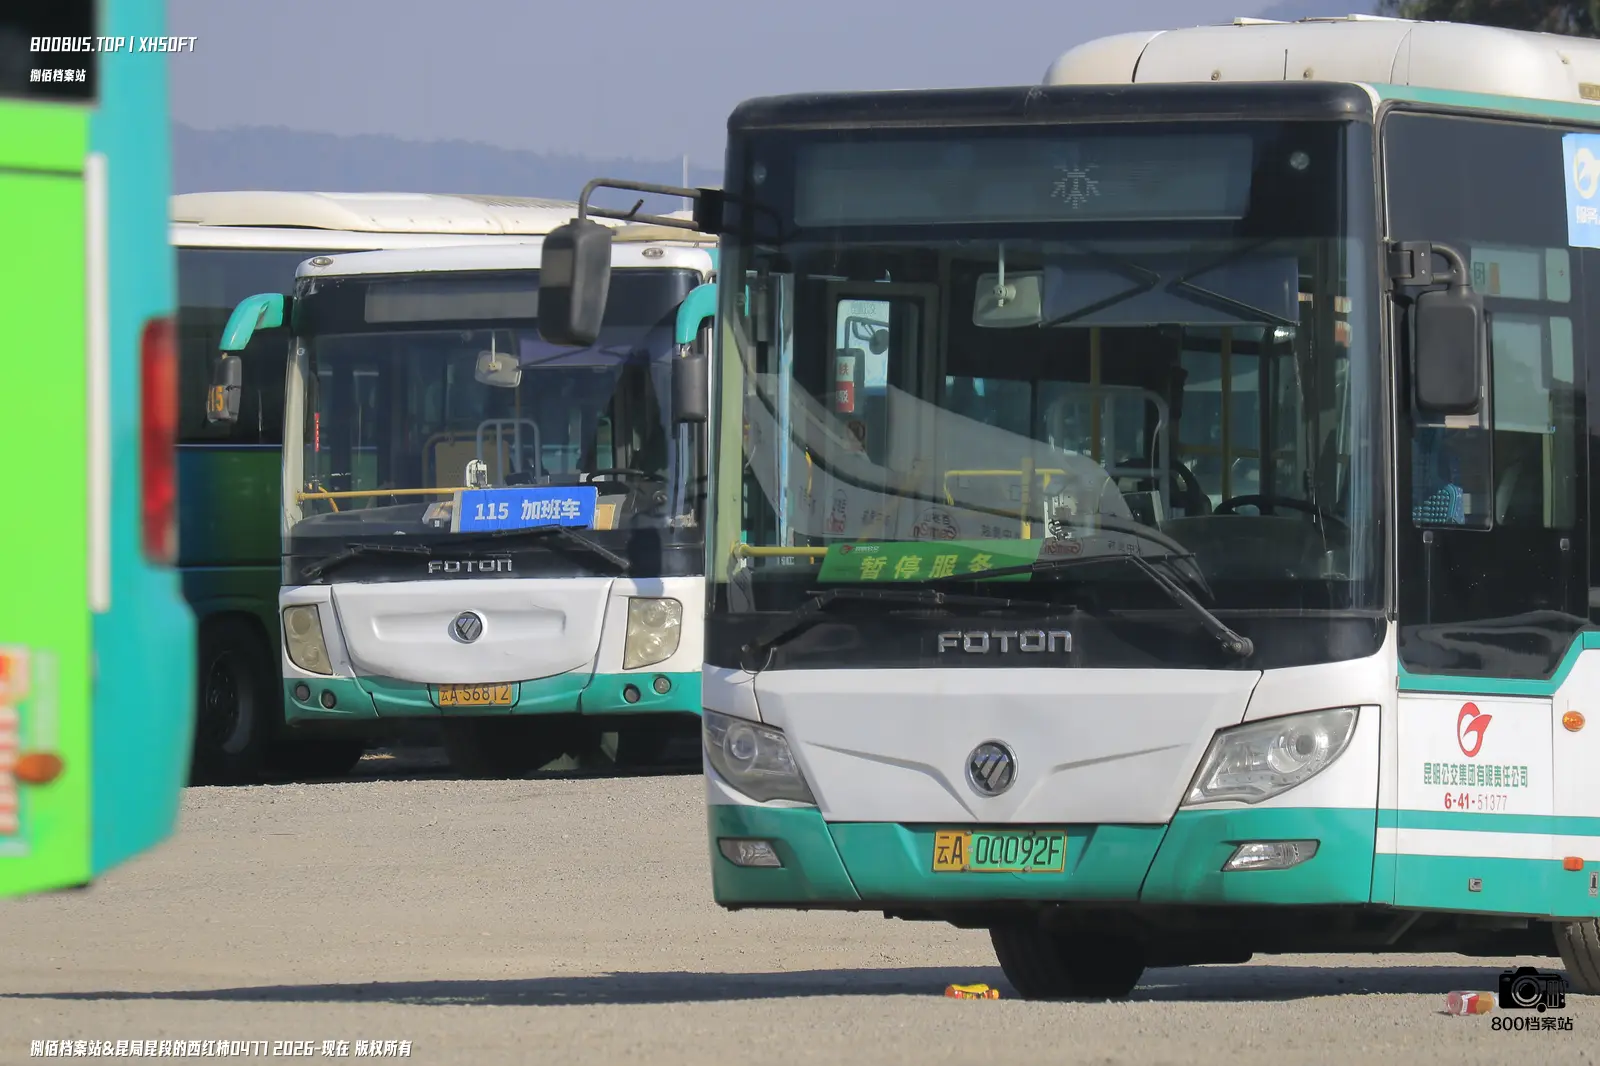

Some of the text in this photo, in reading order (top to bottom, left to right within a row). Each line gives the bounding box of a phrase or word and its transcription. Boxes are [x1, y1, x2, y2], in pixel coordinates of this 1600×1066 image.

[474, 498, 581, 521] 115 加班车
[427, 558, 513, 574] FOTON
[859, 552, 994, 580] 暂停服务
[937, 629, 1073, 654] FOTON
[1423, 762, 1528, 788] 昆明公交集团有限责任公司
